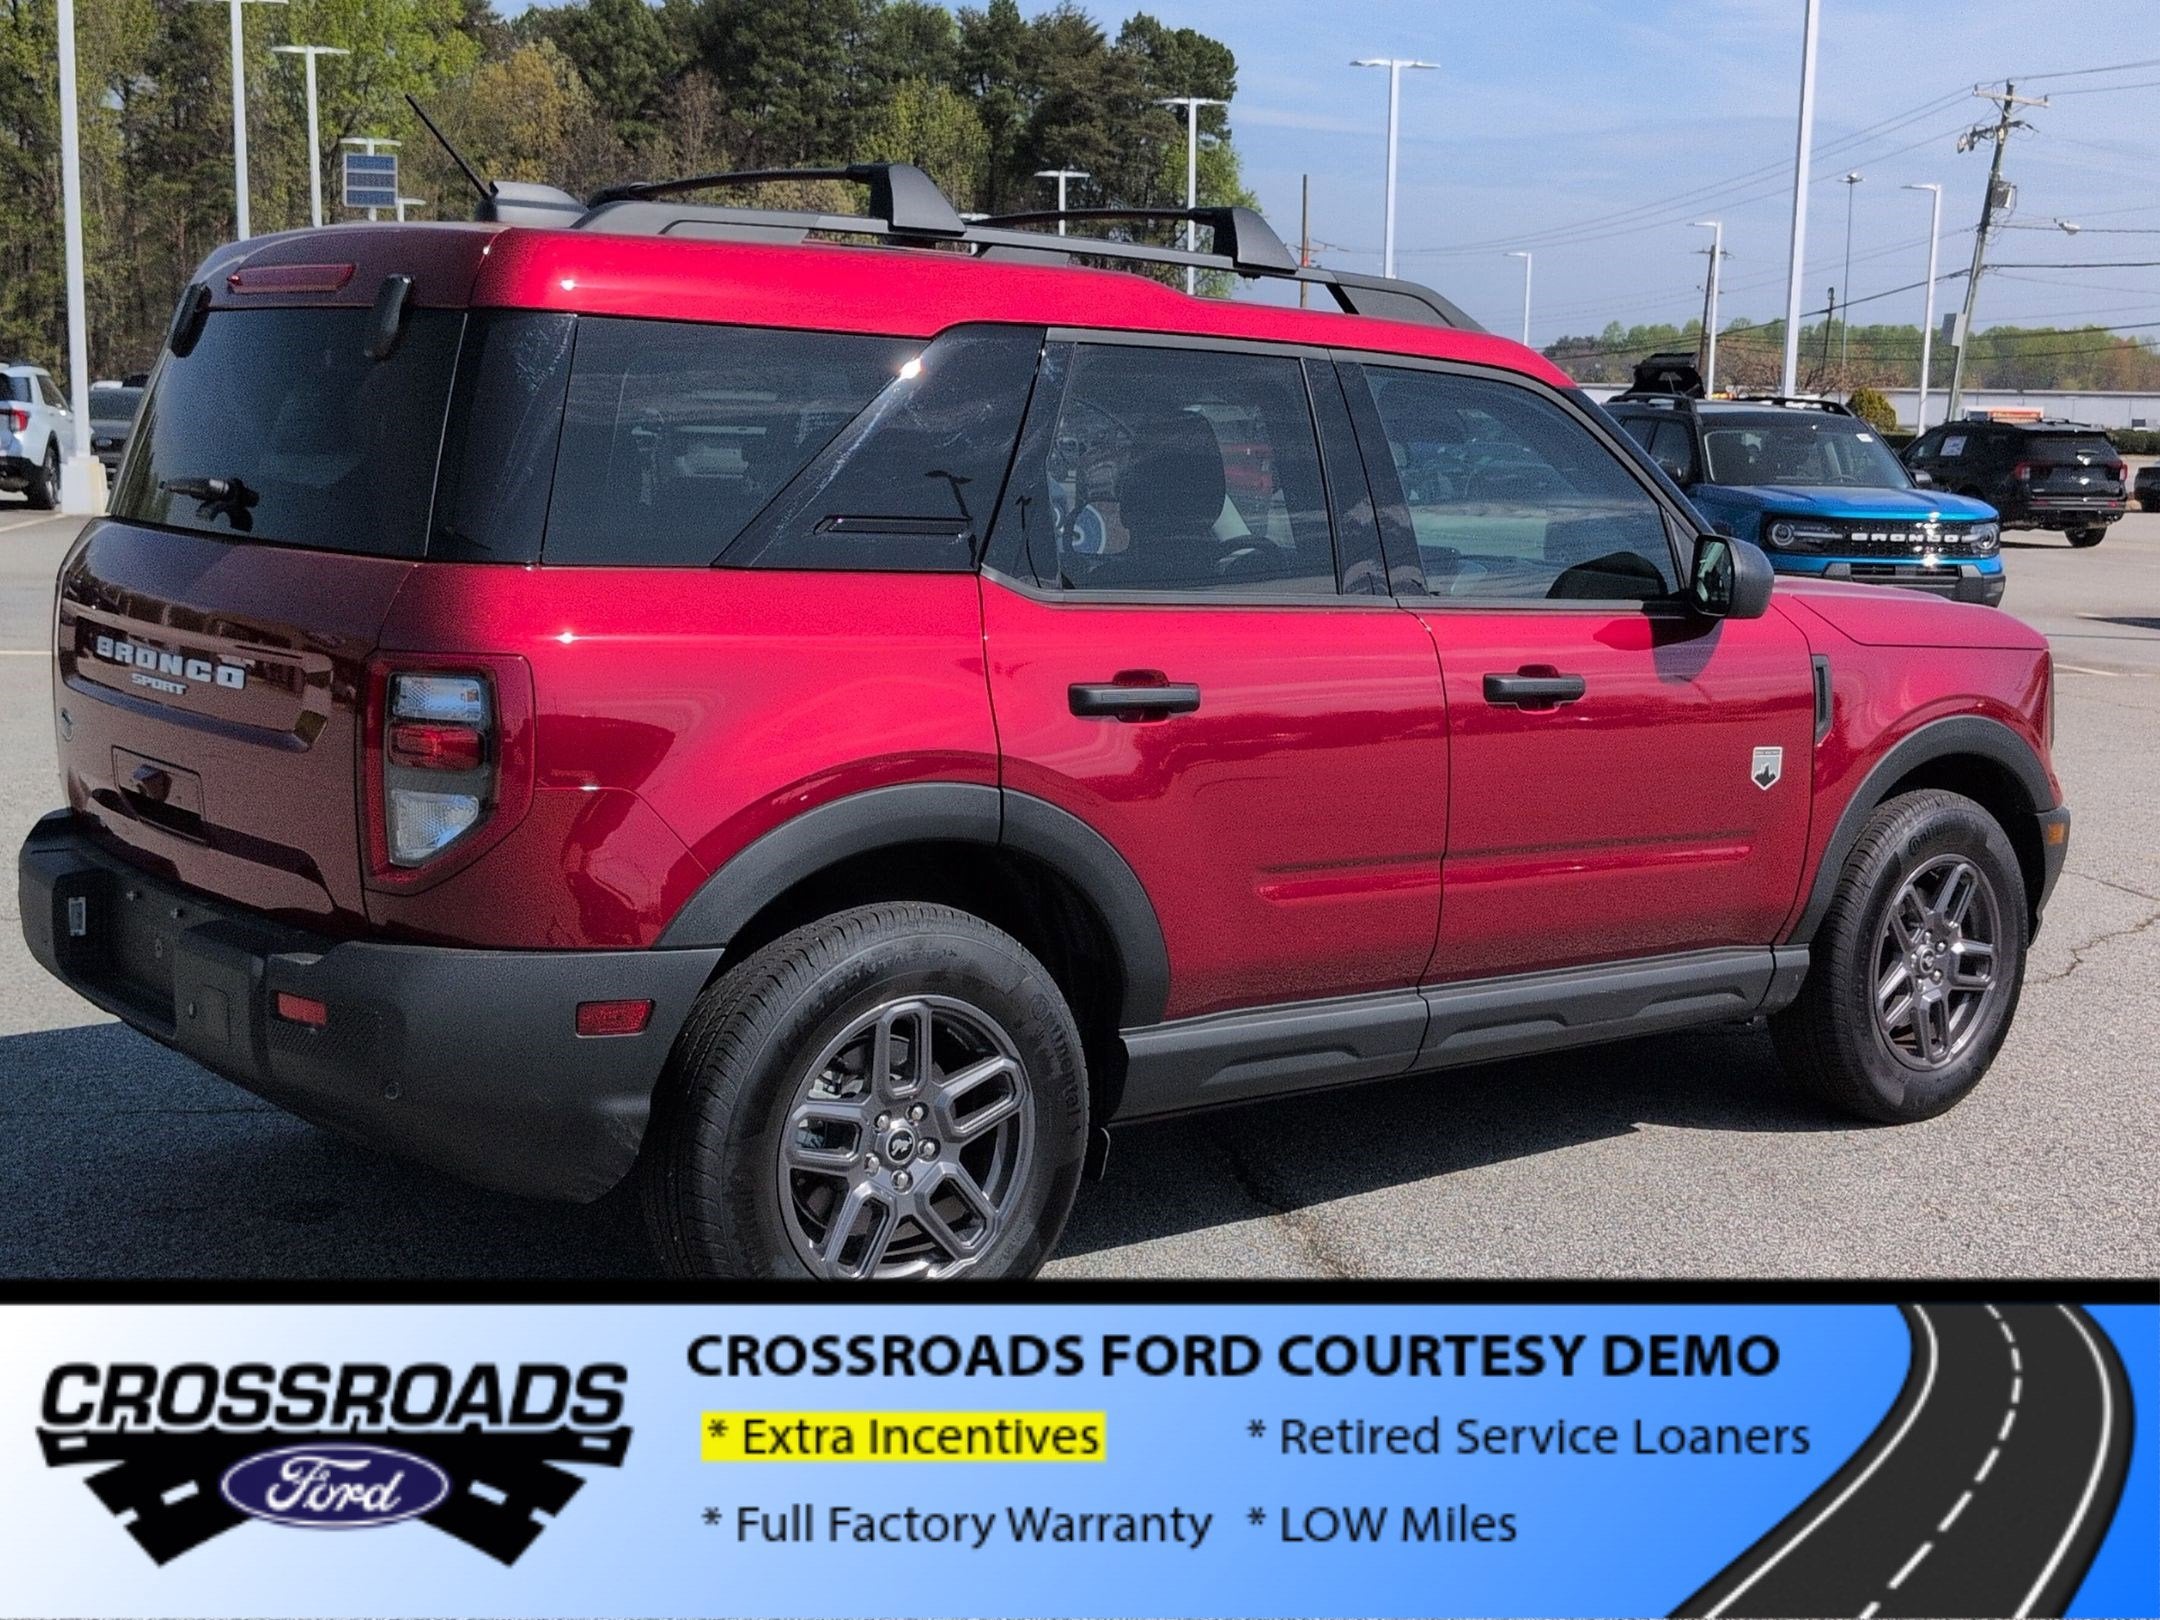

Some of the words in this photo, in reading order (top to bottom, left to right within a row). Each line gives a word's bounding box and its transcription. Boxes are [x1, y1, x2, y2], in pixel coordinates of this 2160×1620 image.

[1851, 532, 1960, 543] BRONCO
[96, 634, 245, 690] BRONCO
[131, 672, 188, 696] SPORT
